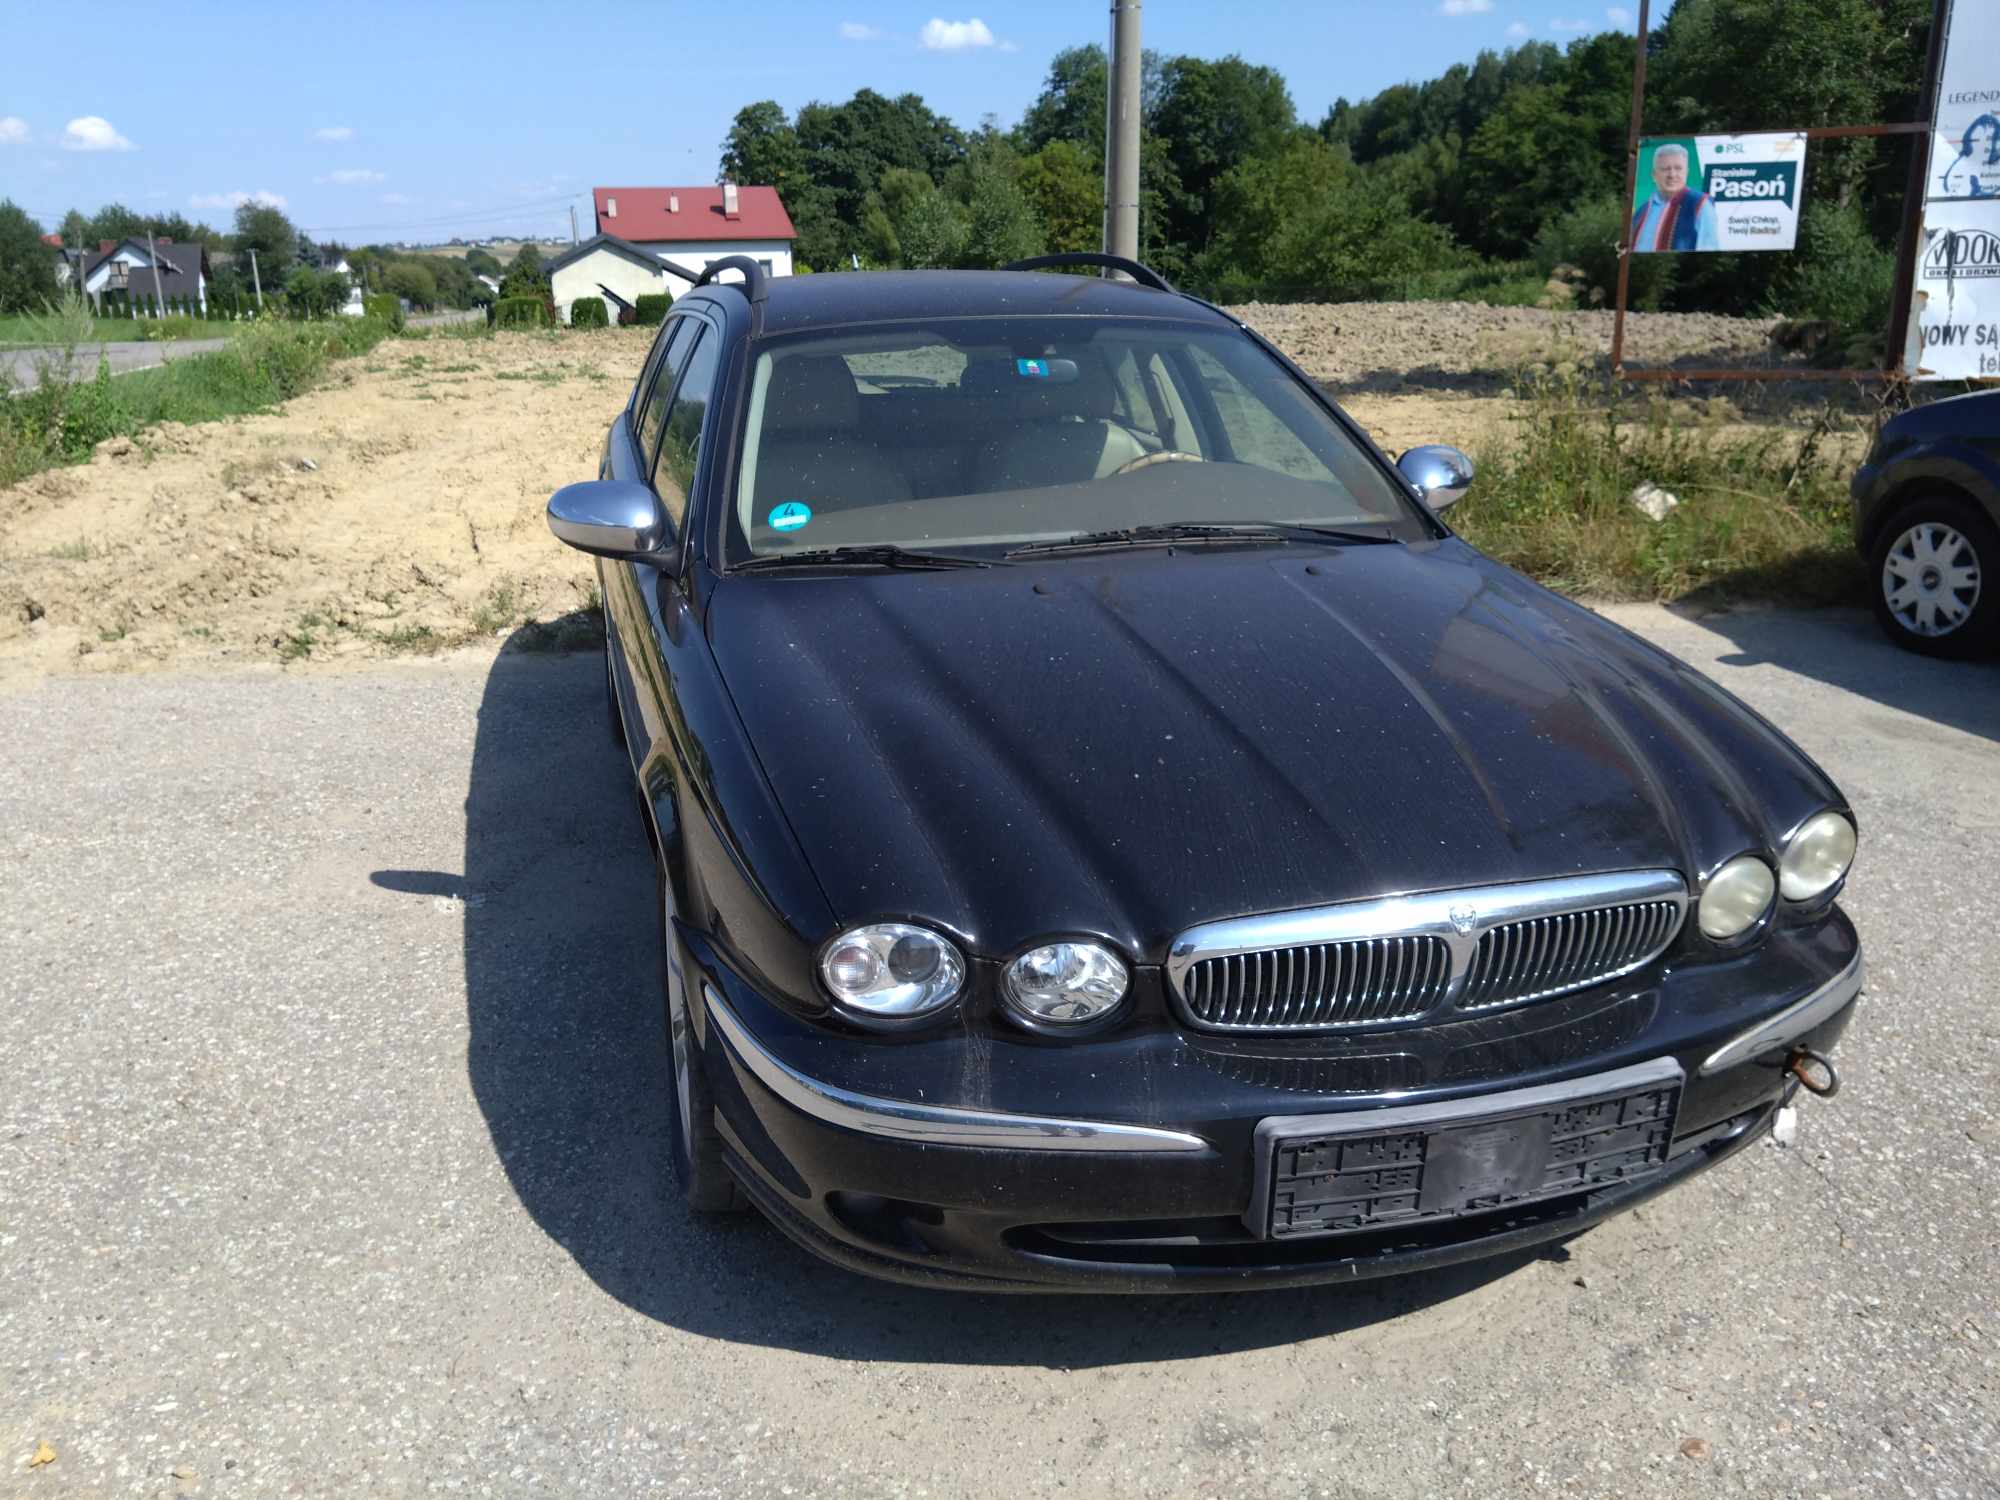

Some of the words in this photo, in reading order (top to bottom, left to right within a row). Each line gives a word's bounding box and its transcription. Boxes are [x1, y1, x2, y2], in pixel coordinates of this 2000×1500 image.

[1726, 143, 1744, 154] PSL
[1710, 174, 1785, 197] Pasoń
[784, 504, 795, 516] 4
